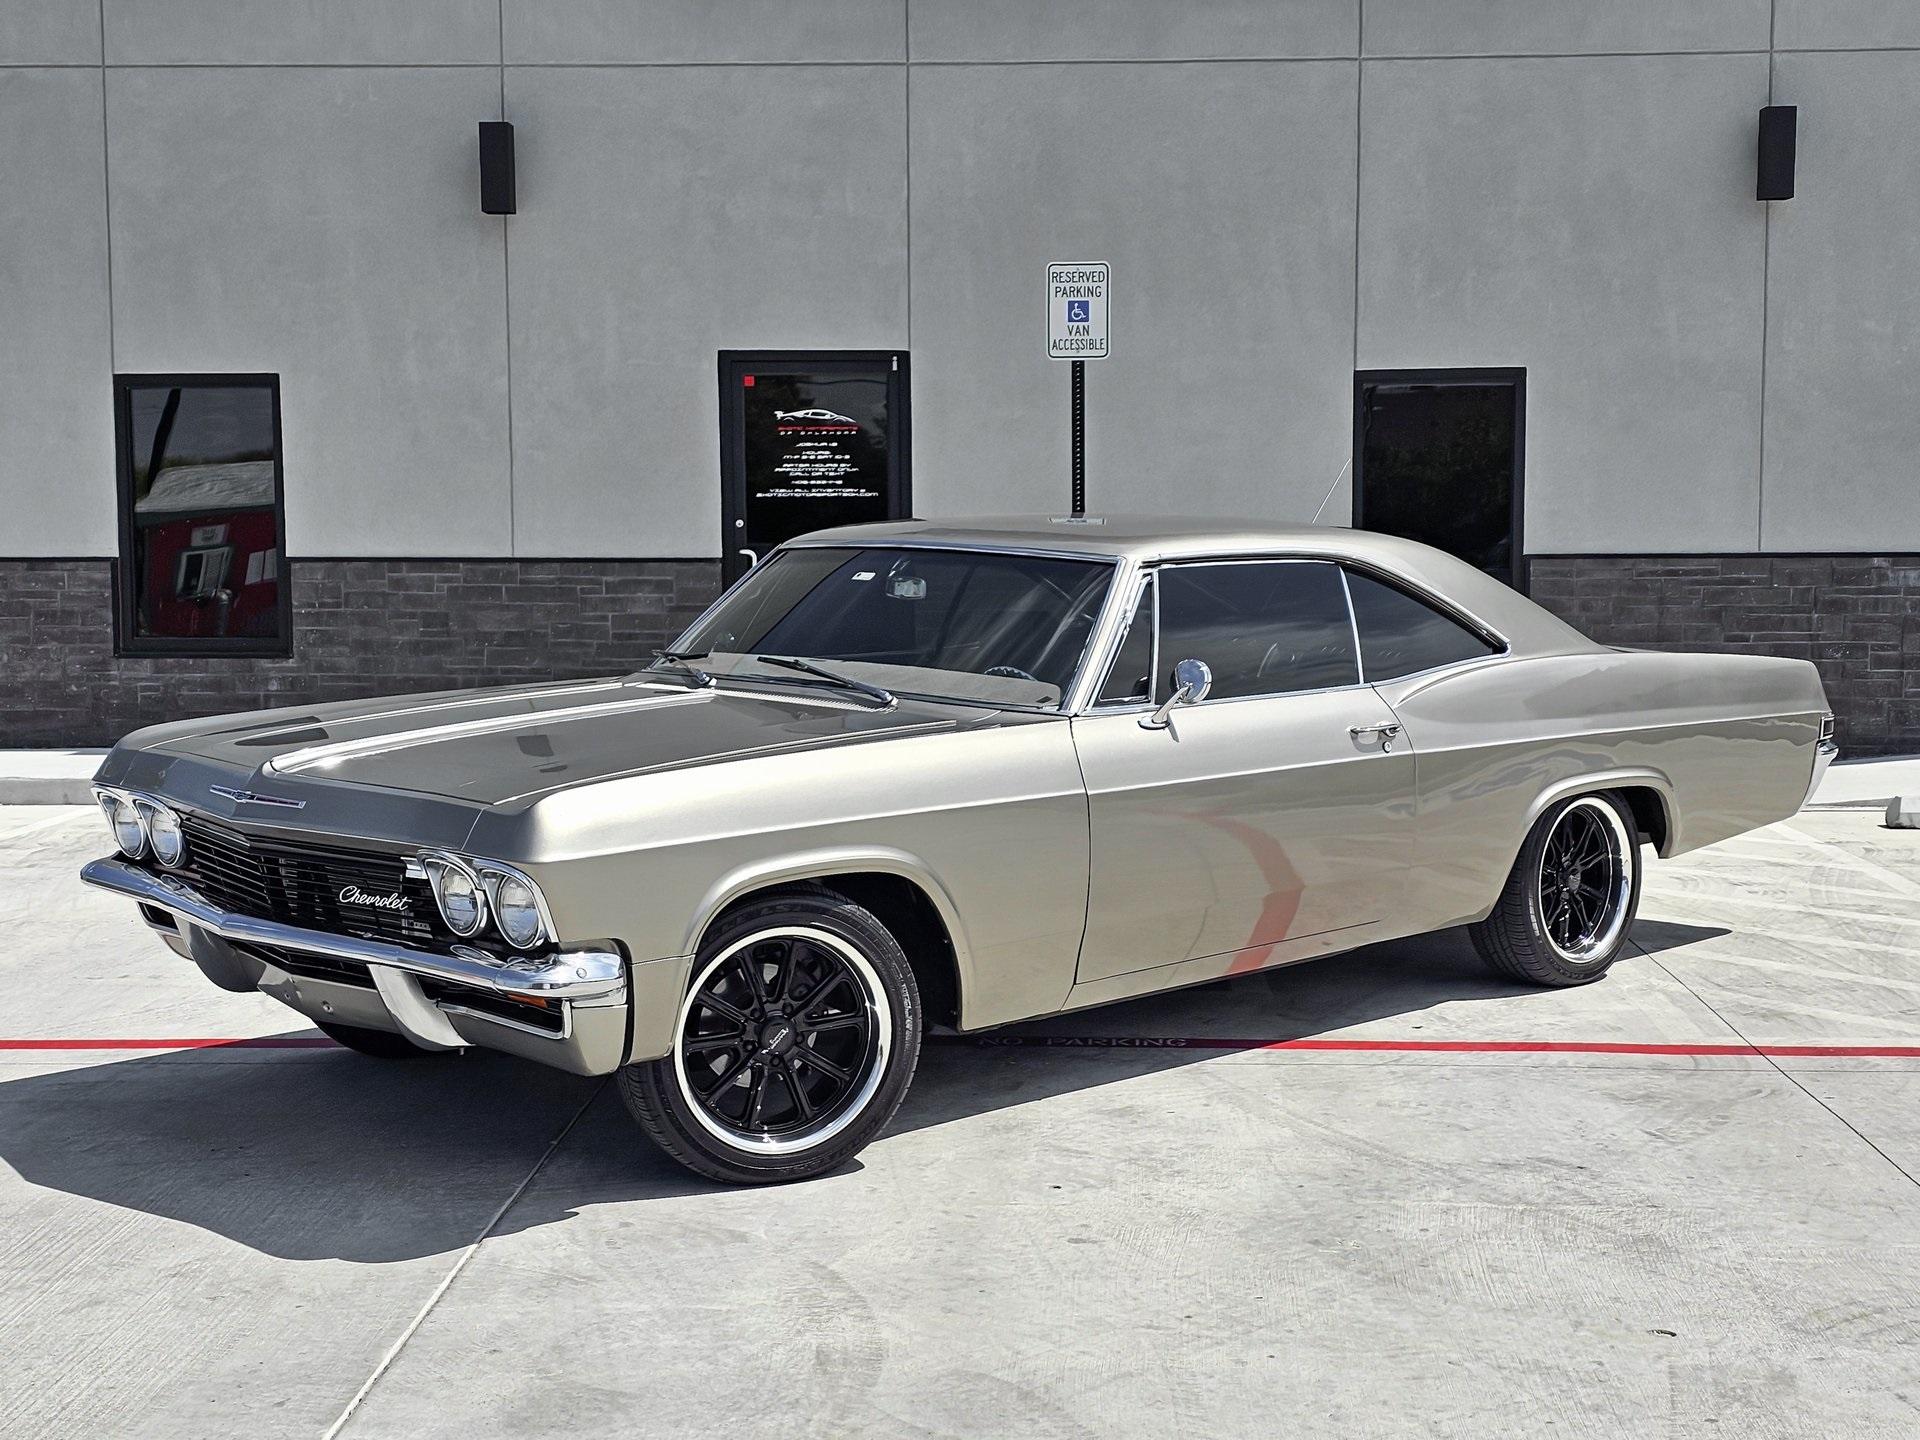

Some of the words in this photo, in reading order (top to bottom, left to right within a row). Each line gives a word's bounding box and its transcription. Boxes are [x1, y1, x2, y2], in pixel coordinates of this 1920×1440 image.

[1051, 271, 1105, 283] RESERVED
[1055, 286, 1102, 298] PARKING
[1067, 325, 1090, 336] VAN
[1052, 338, 1105, 350] ACCESSIBLE
[339, 885, 413, 911] Chevrolet
[978, 1037, 1024, 1046] NO
[1046, 1037, 1188, 1047] PARKING
